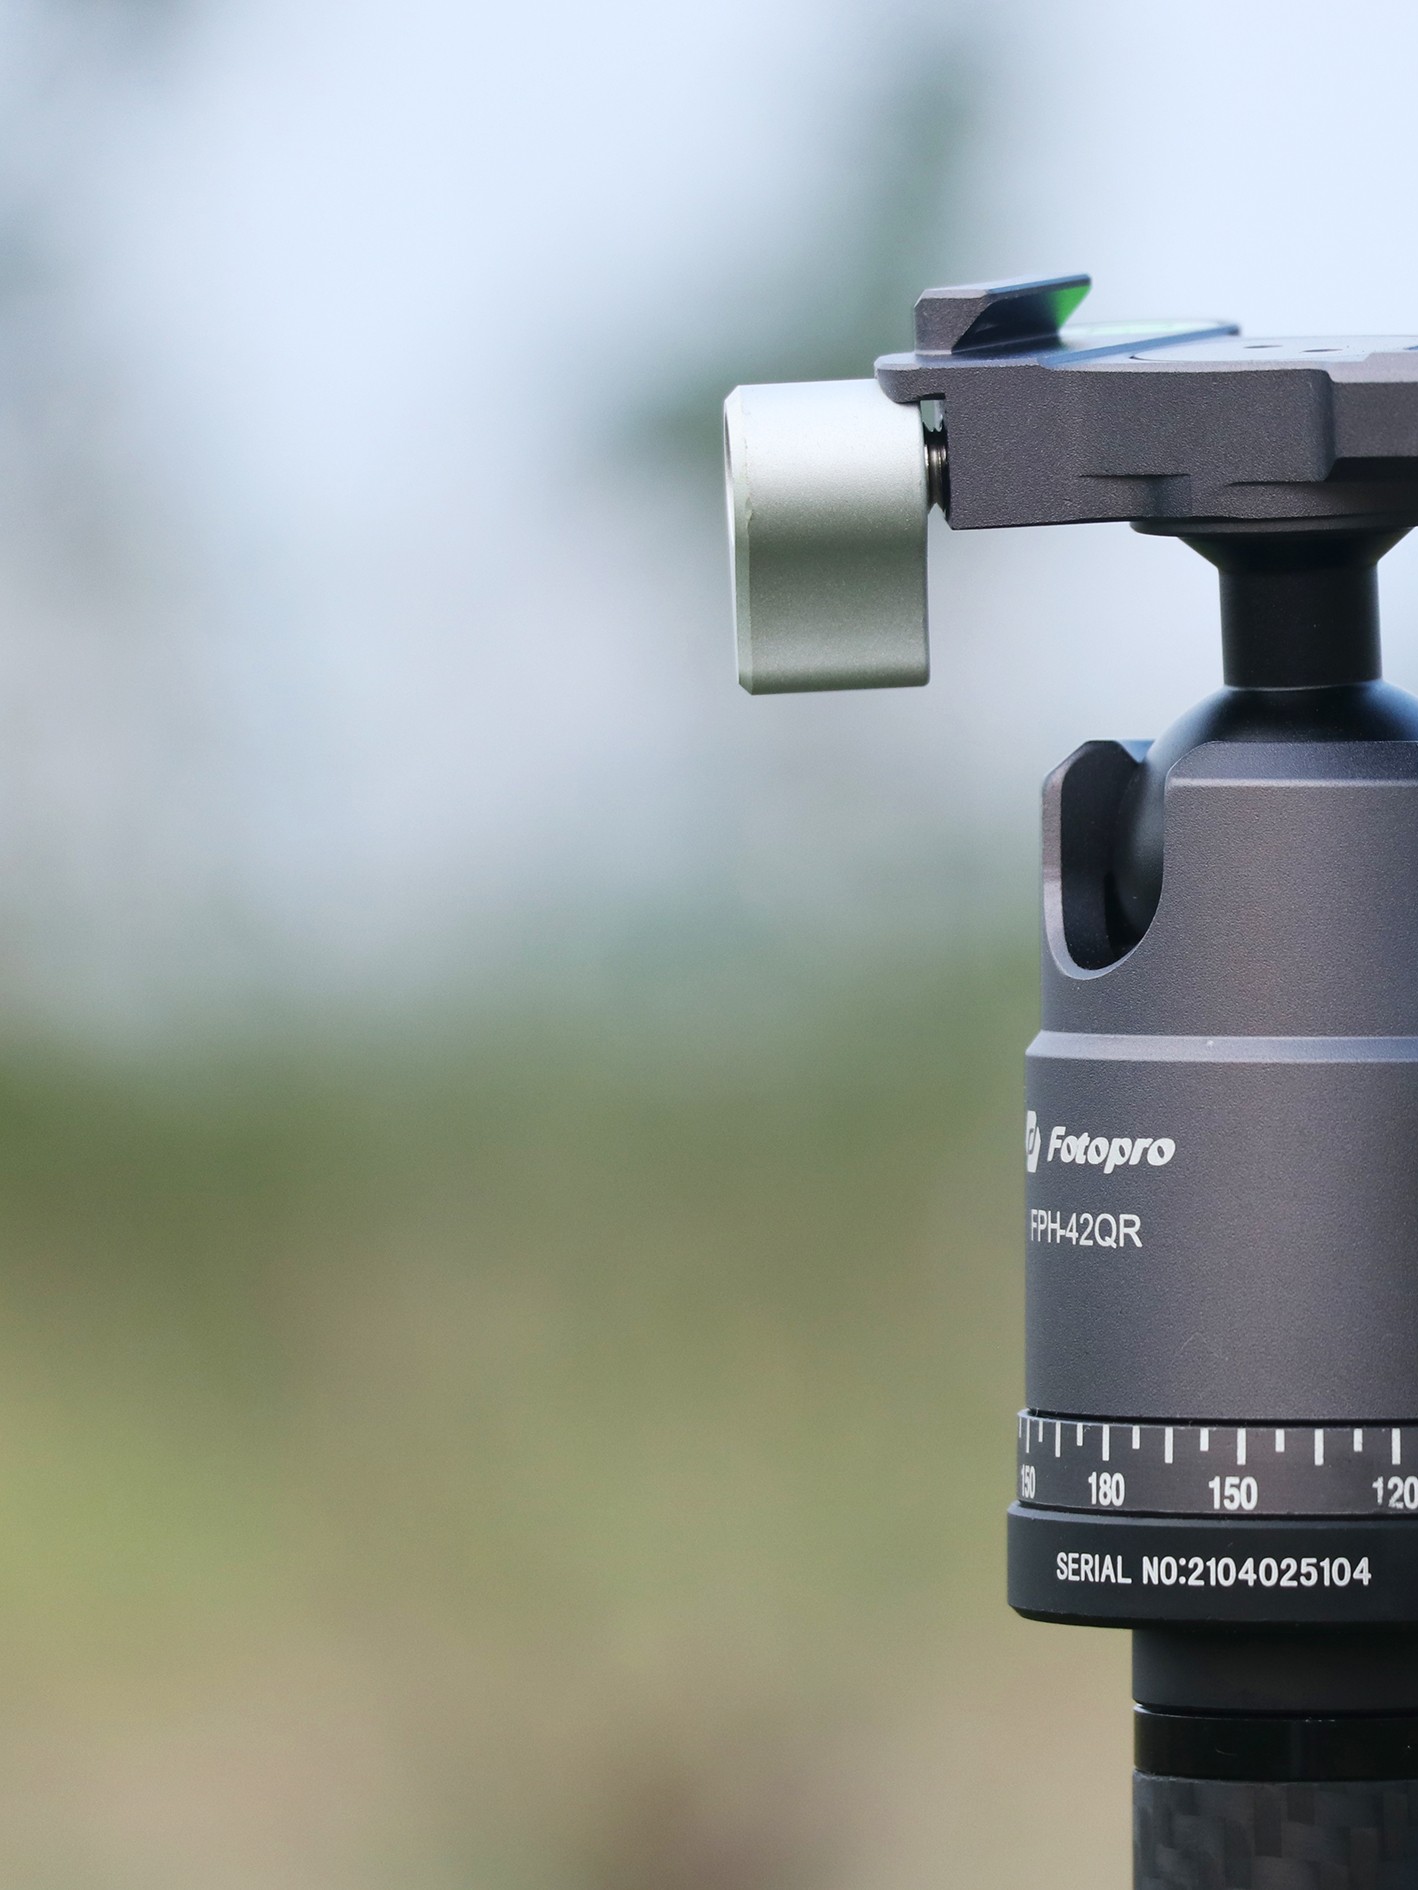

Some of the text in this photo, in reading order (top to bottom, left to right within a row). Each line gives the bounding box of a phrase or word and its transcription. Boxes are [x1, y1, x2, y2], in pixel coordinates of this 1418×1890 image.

[1047, 1126, 1176, 1174] Fotopro
[1030, 1208, 1143, 1249] FPH-42QR
[1088, 1471, 1126, 1507] 180
[1208, 1475, 1259, 1511] 150
[1055, 1551, 1133, 1585] SERIAL
